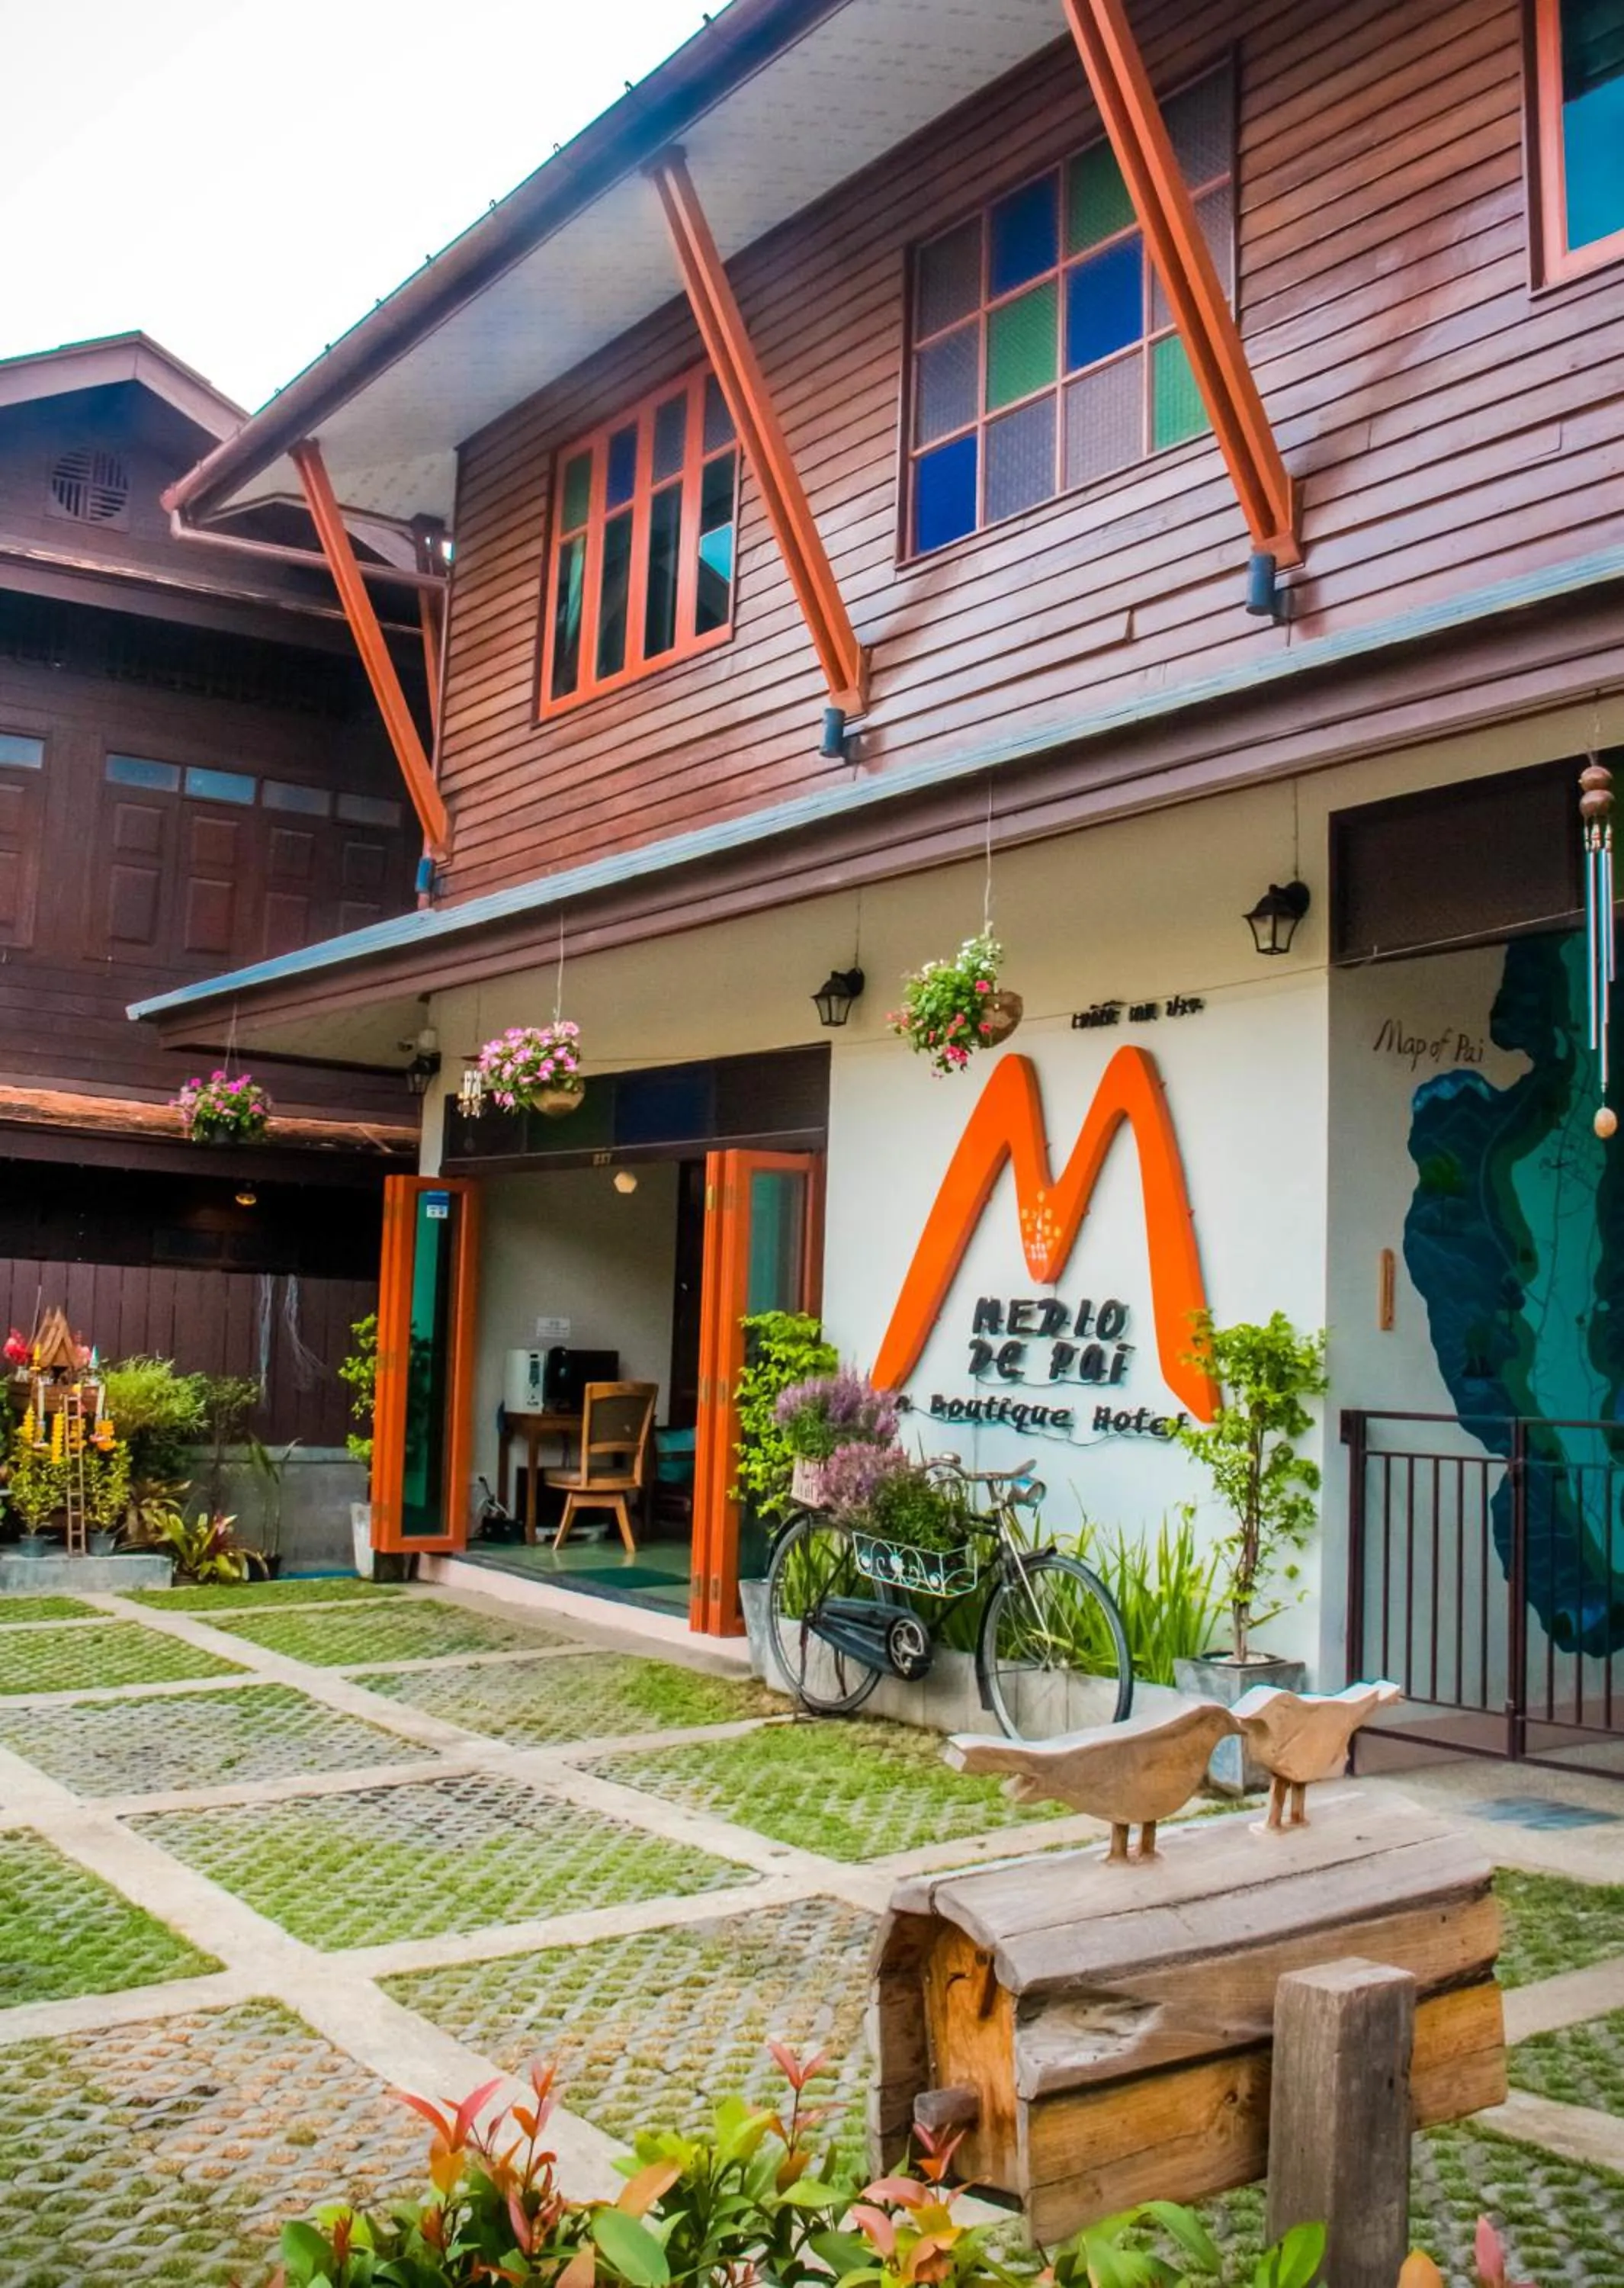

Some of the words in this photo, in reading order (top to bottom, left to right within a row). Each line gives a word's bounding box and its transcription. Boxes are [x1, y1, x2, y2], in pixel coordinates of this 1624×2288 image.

[1373, 1019, 1427, 1072] Map
[1430, 1026, 1452, 1062] of
[1454, 1033, 1484, 1062] Pai
[973, 1297, 1128, 1340] MEDIO
[930, 1394, 1074, 1434] Boutique
[1093, 1405, 1189, 1441] Hotel
